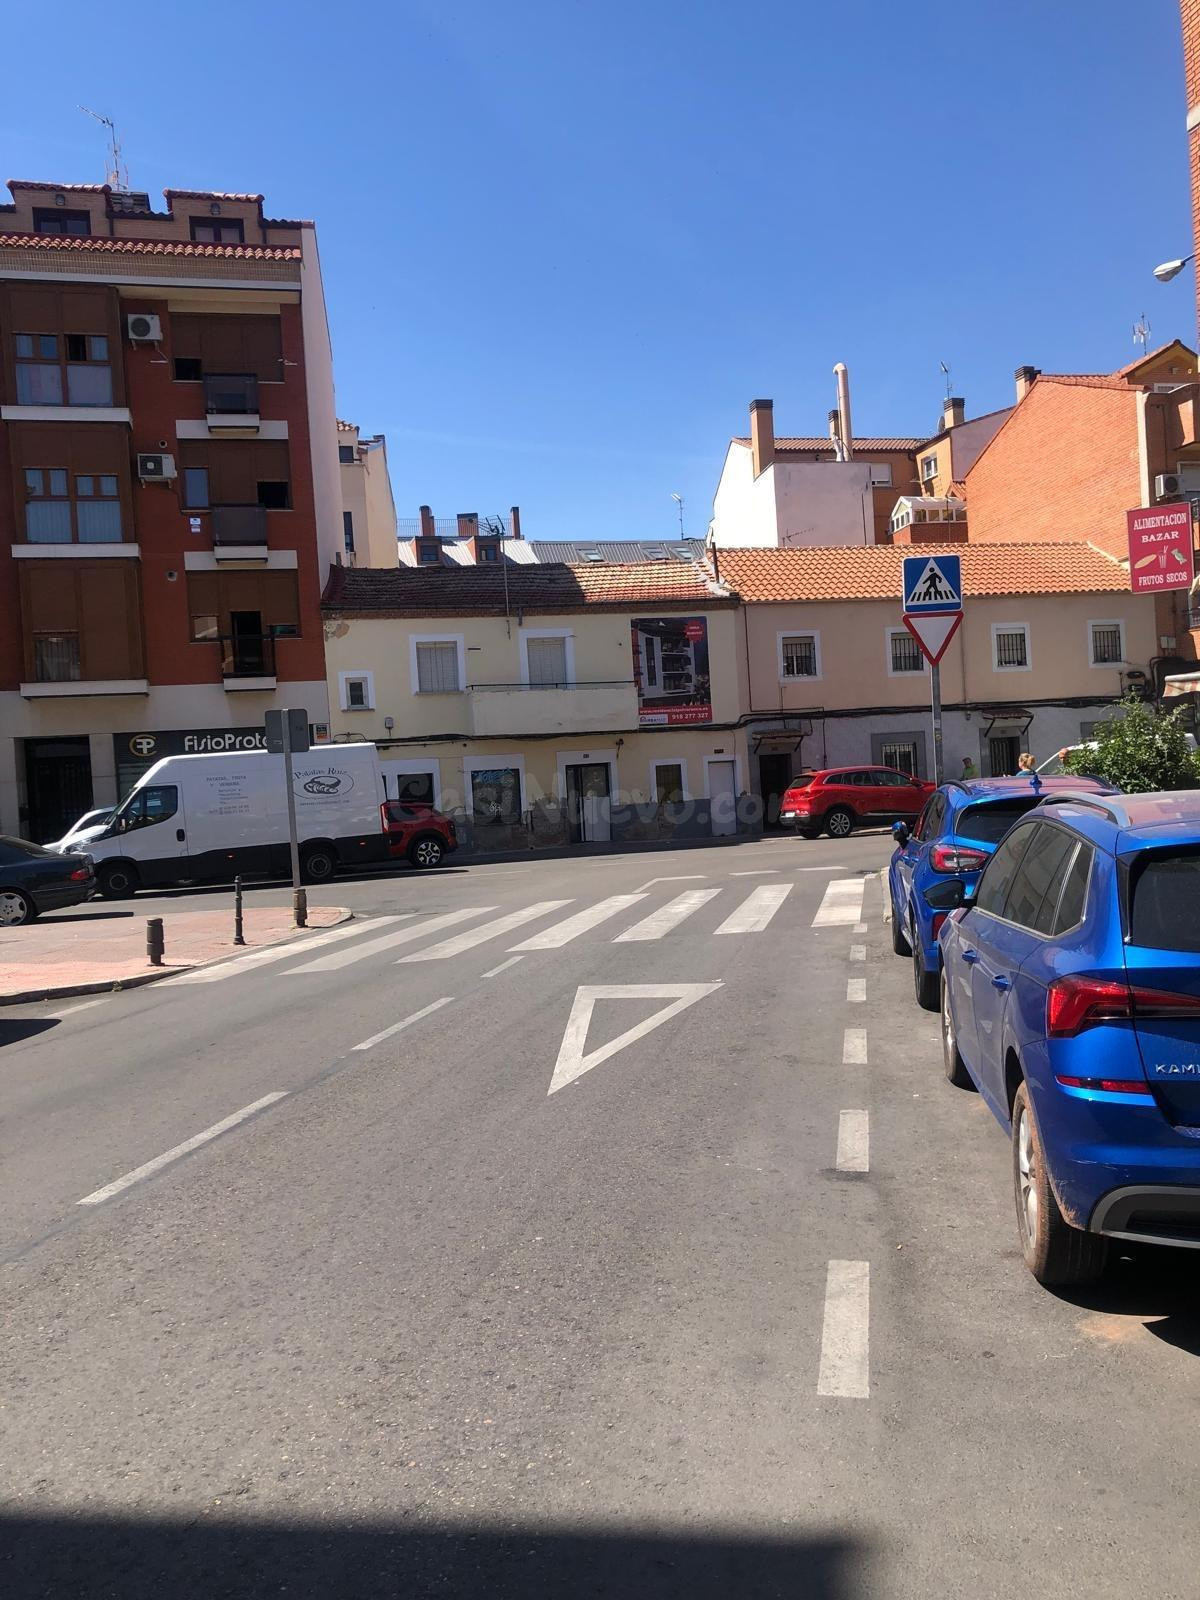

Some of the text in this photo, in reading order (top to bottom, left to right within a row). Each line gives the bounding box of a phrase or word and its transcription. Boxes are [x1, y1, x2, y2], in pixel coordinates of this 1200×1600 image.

[1133, 512, 1187, 530] ALIMENTACION
[1141, 531, 1179, 543] BAZAR
[1138, 571, 1187, 586] FRUTOS SECOS
[294, 769, 325, 780] Patatas
